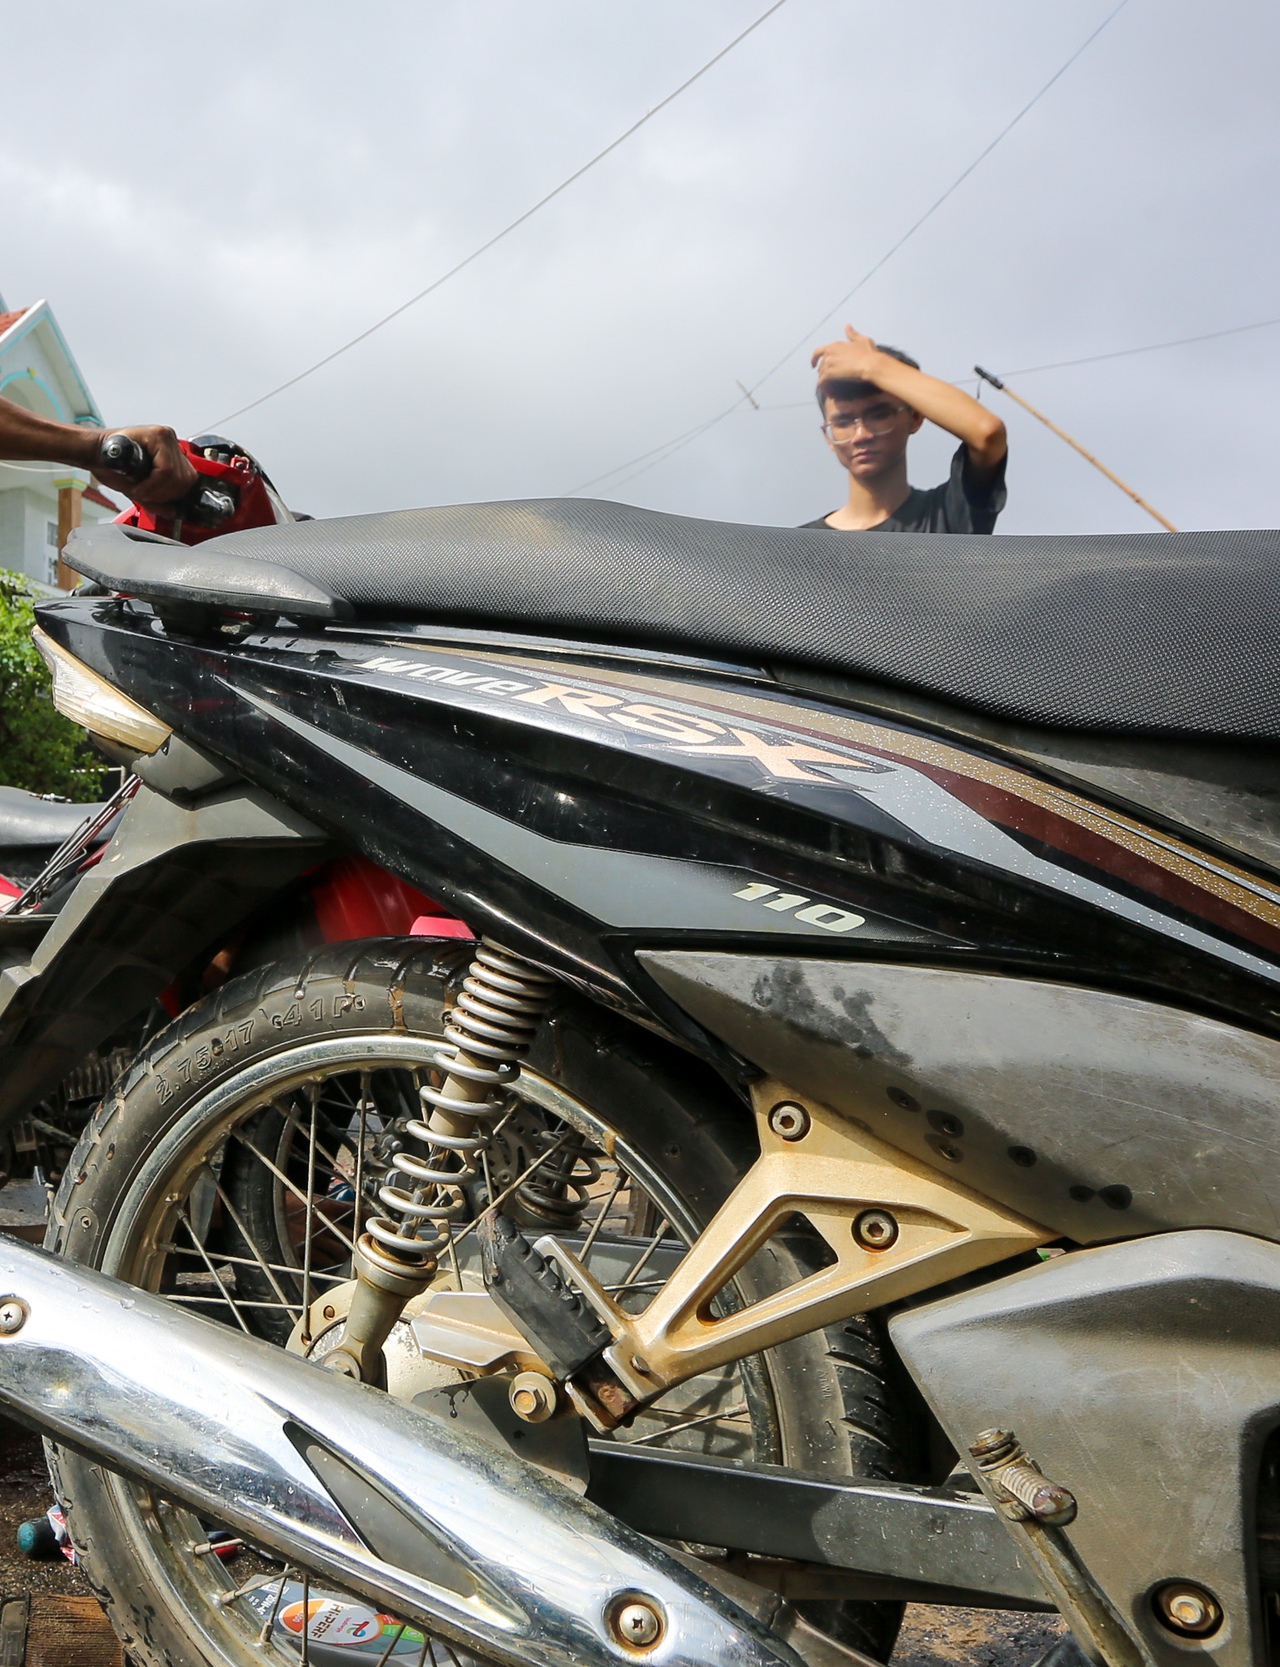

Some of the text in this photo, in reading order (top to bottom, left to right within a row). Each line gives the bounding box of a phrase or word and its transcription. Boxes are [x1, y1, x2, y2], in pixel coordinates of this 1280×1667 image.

[512, 682, 888, 787] RSX
[732, 882, 866, 932] 110
[155, 1019, 255, 1105] 2.7517
